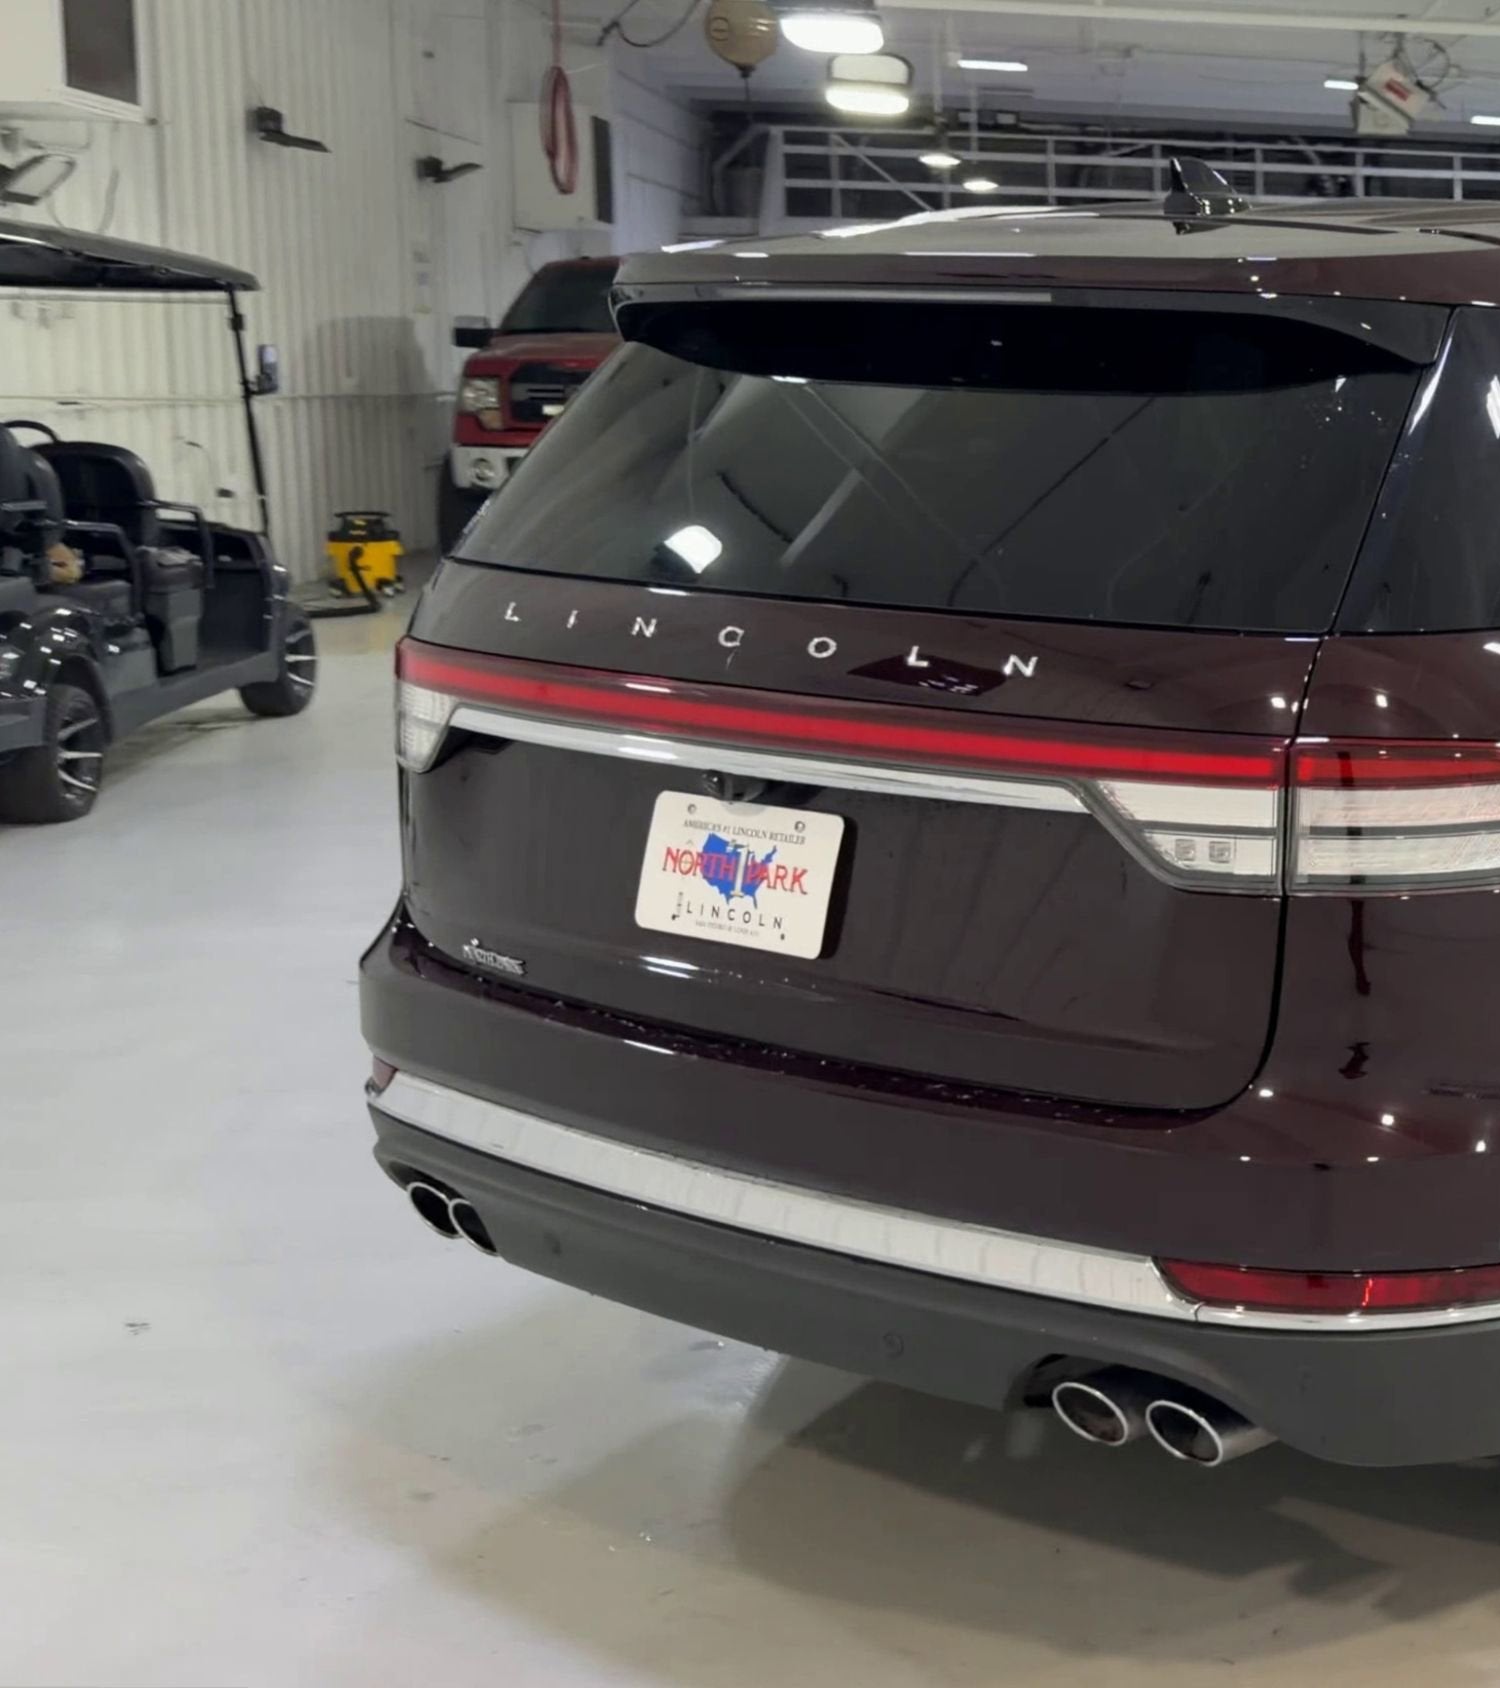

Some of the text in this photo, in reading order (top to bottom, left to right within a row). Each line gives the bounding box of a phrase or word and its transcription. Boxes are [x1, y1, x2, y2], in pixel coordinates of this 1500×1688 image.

[504, 601, 1038, 677] LINCOLN
[732, 827, 767, 840] LINCOLN
[768, 832, 806, 845] RETAILER
[662, 846, 808, 895] NORTH PARK
[687, 900, 783, 929] LINCOLN
